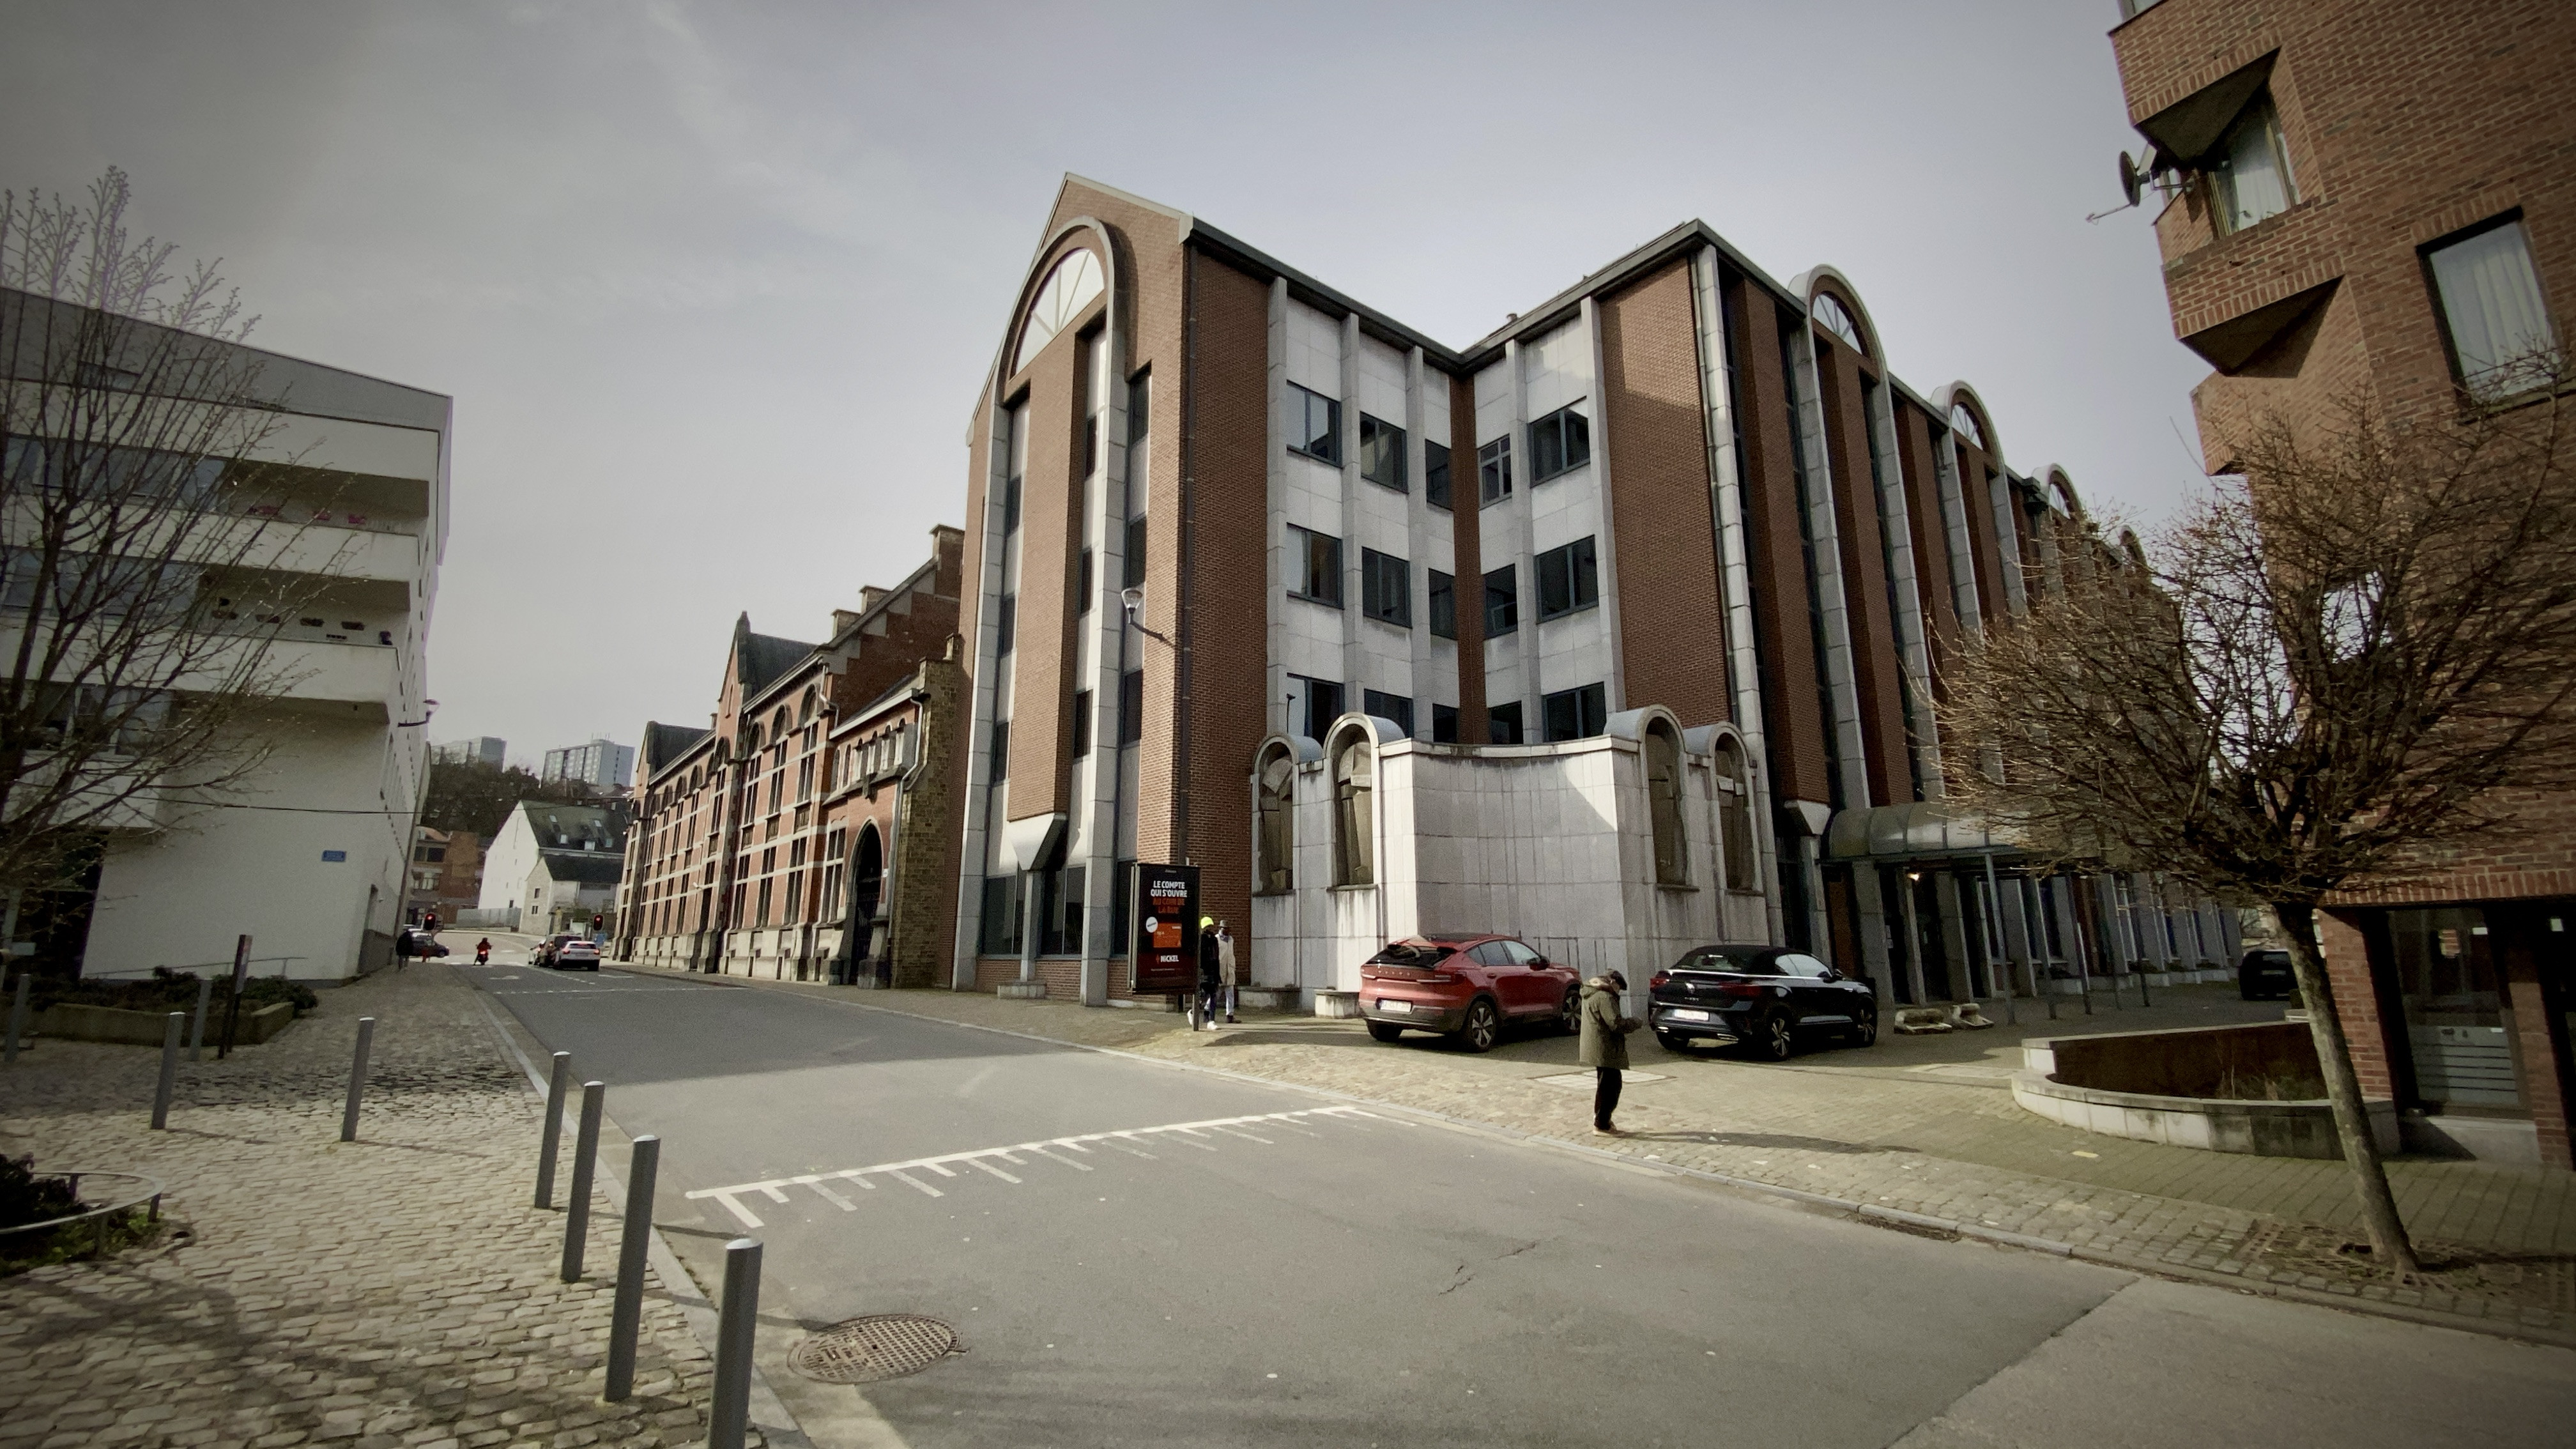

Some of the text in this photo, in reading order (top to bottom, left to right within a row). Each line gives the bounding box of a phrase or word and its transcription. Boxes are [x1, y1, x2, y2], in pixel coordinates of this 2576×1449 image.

[1162, 880, 1185, 889] COMPTE
[1151, 889, 1187, 898] QUI S'OUVRE
